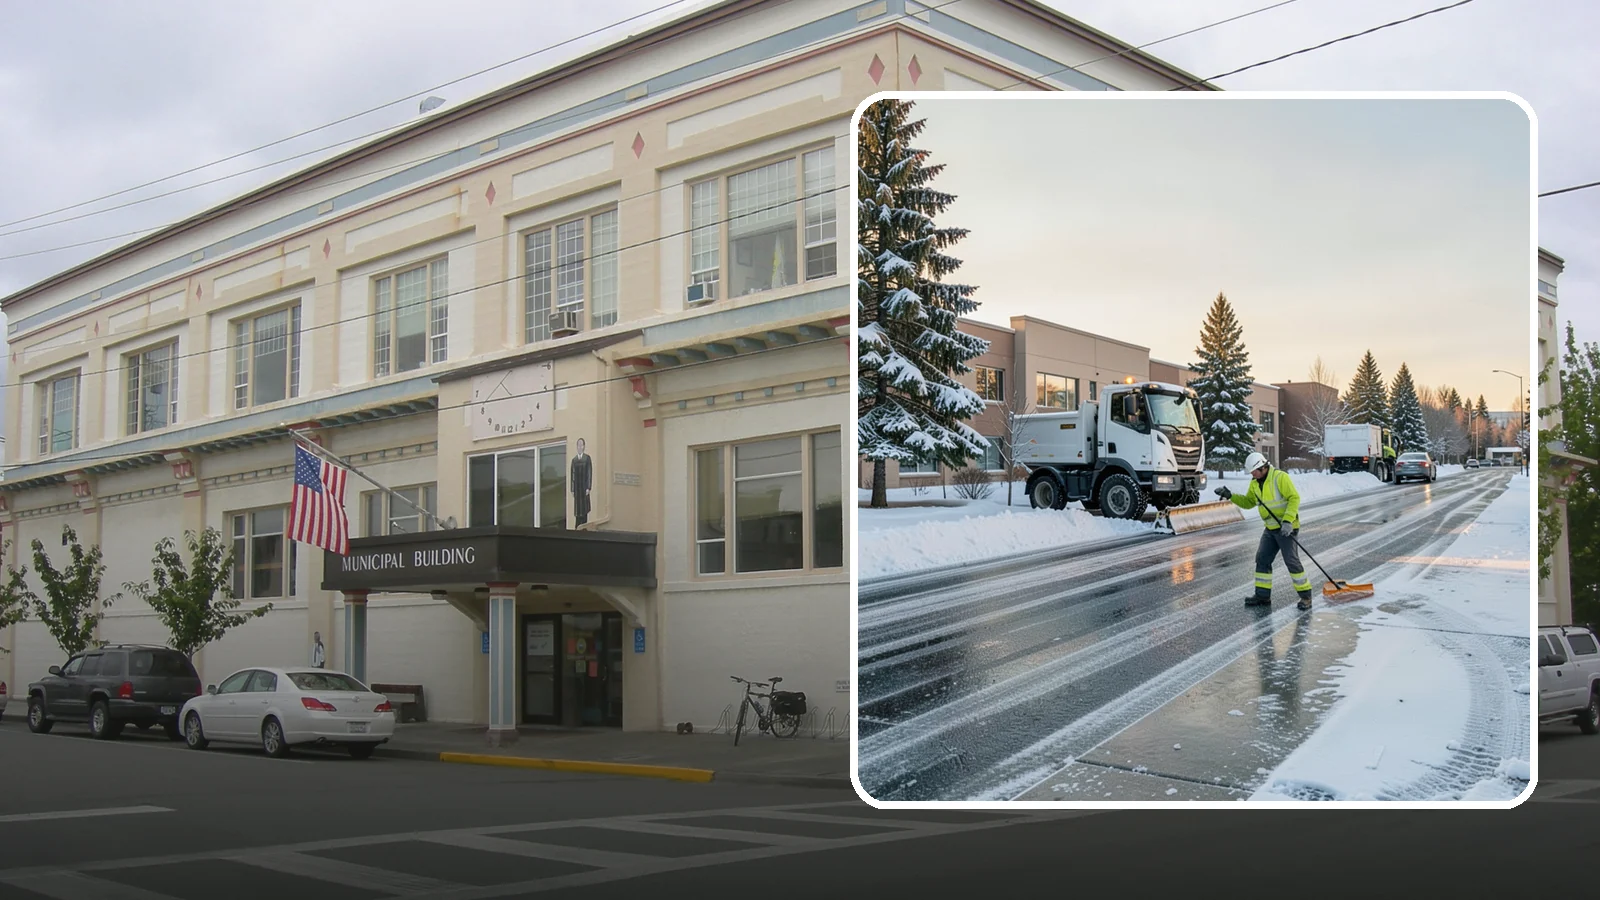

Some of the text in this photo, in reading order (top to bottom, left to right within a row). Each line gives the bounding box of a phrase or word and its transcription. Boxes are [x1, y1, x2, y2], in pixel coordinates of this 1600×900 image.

[480, 407, 485, 415] 8
[487, 418, 493, 426] 9
[521, 420, 526, 428] 2
[494, 424, 500, 432] 10
[507, 425, 513, 433] 12
[342, 546, 475, 572] MUNICIPAL BUILDING
